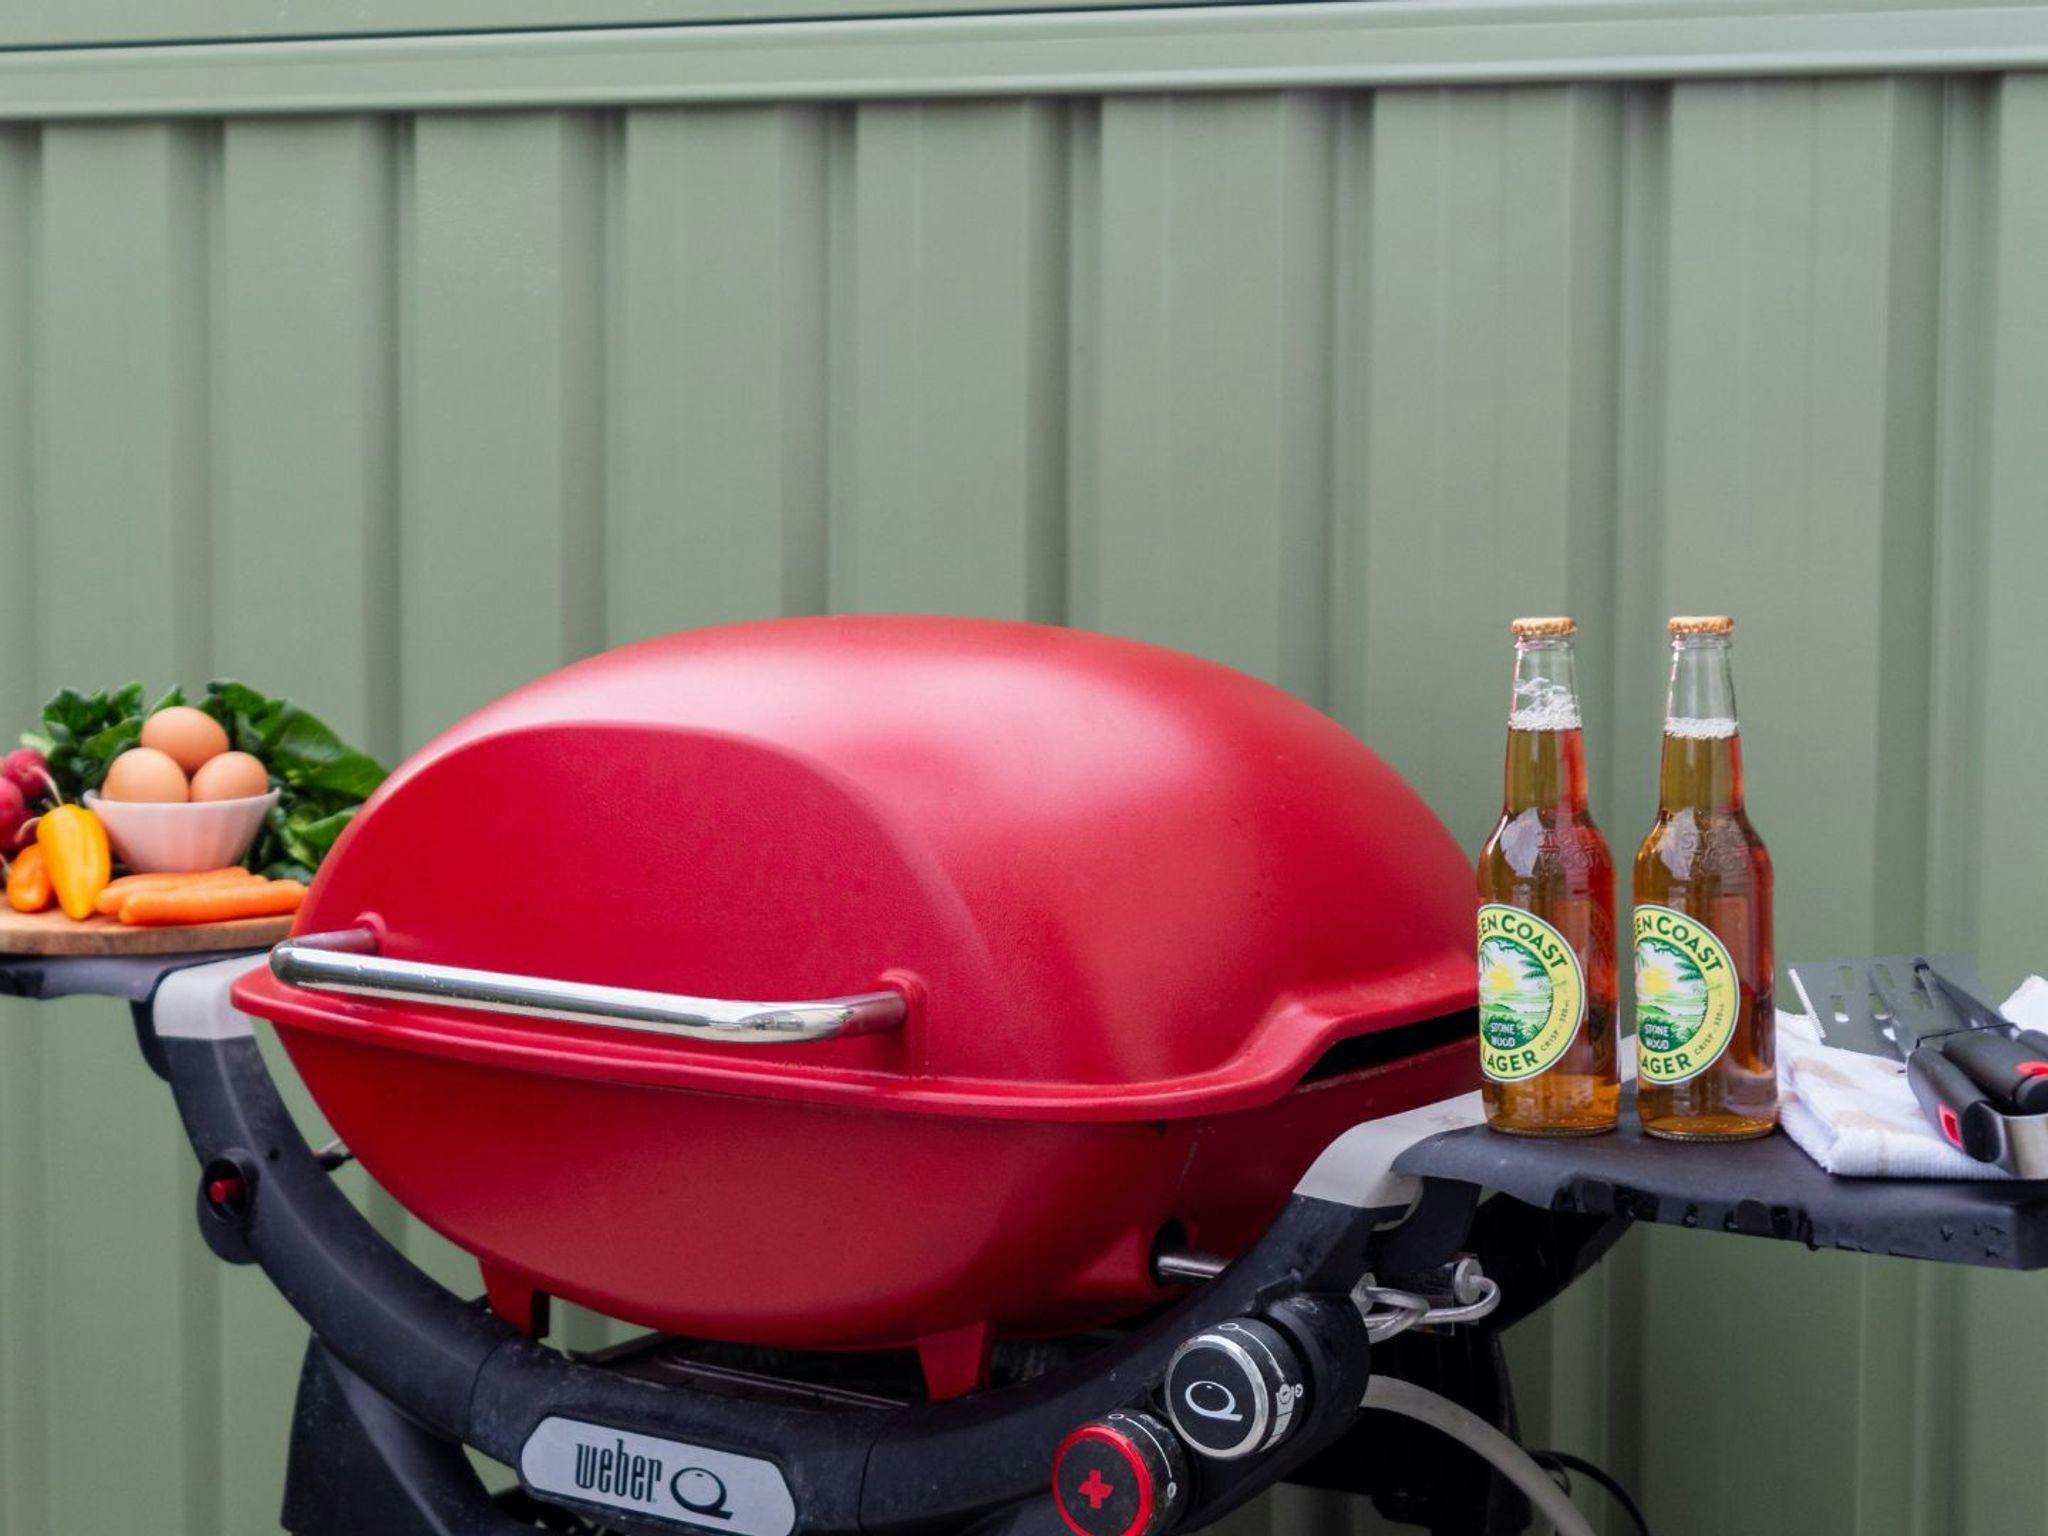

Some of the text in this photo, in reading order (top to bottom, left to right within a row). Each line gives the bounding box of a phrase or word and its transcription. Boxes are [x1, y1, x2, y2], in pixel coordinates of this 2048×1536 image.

[1501, 914, 1568, 968] COAST
[1656, 916, 1723, 971] COAST
[1490, 1022, 1515, 1035] STONE
[1491, 1035, 1516, 1047] WOOD
[1640, 1052, 1692, 1074] AGER
[576, 1438, 733, 1520] weber Q
